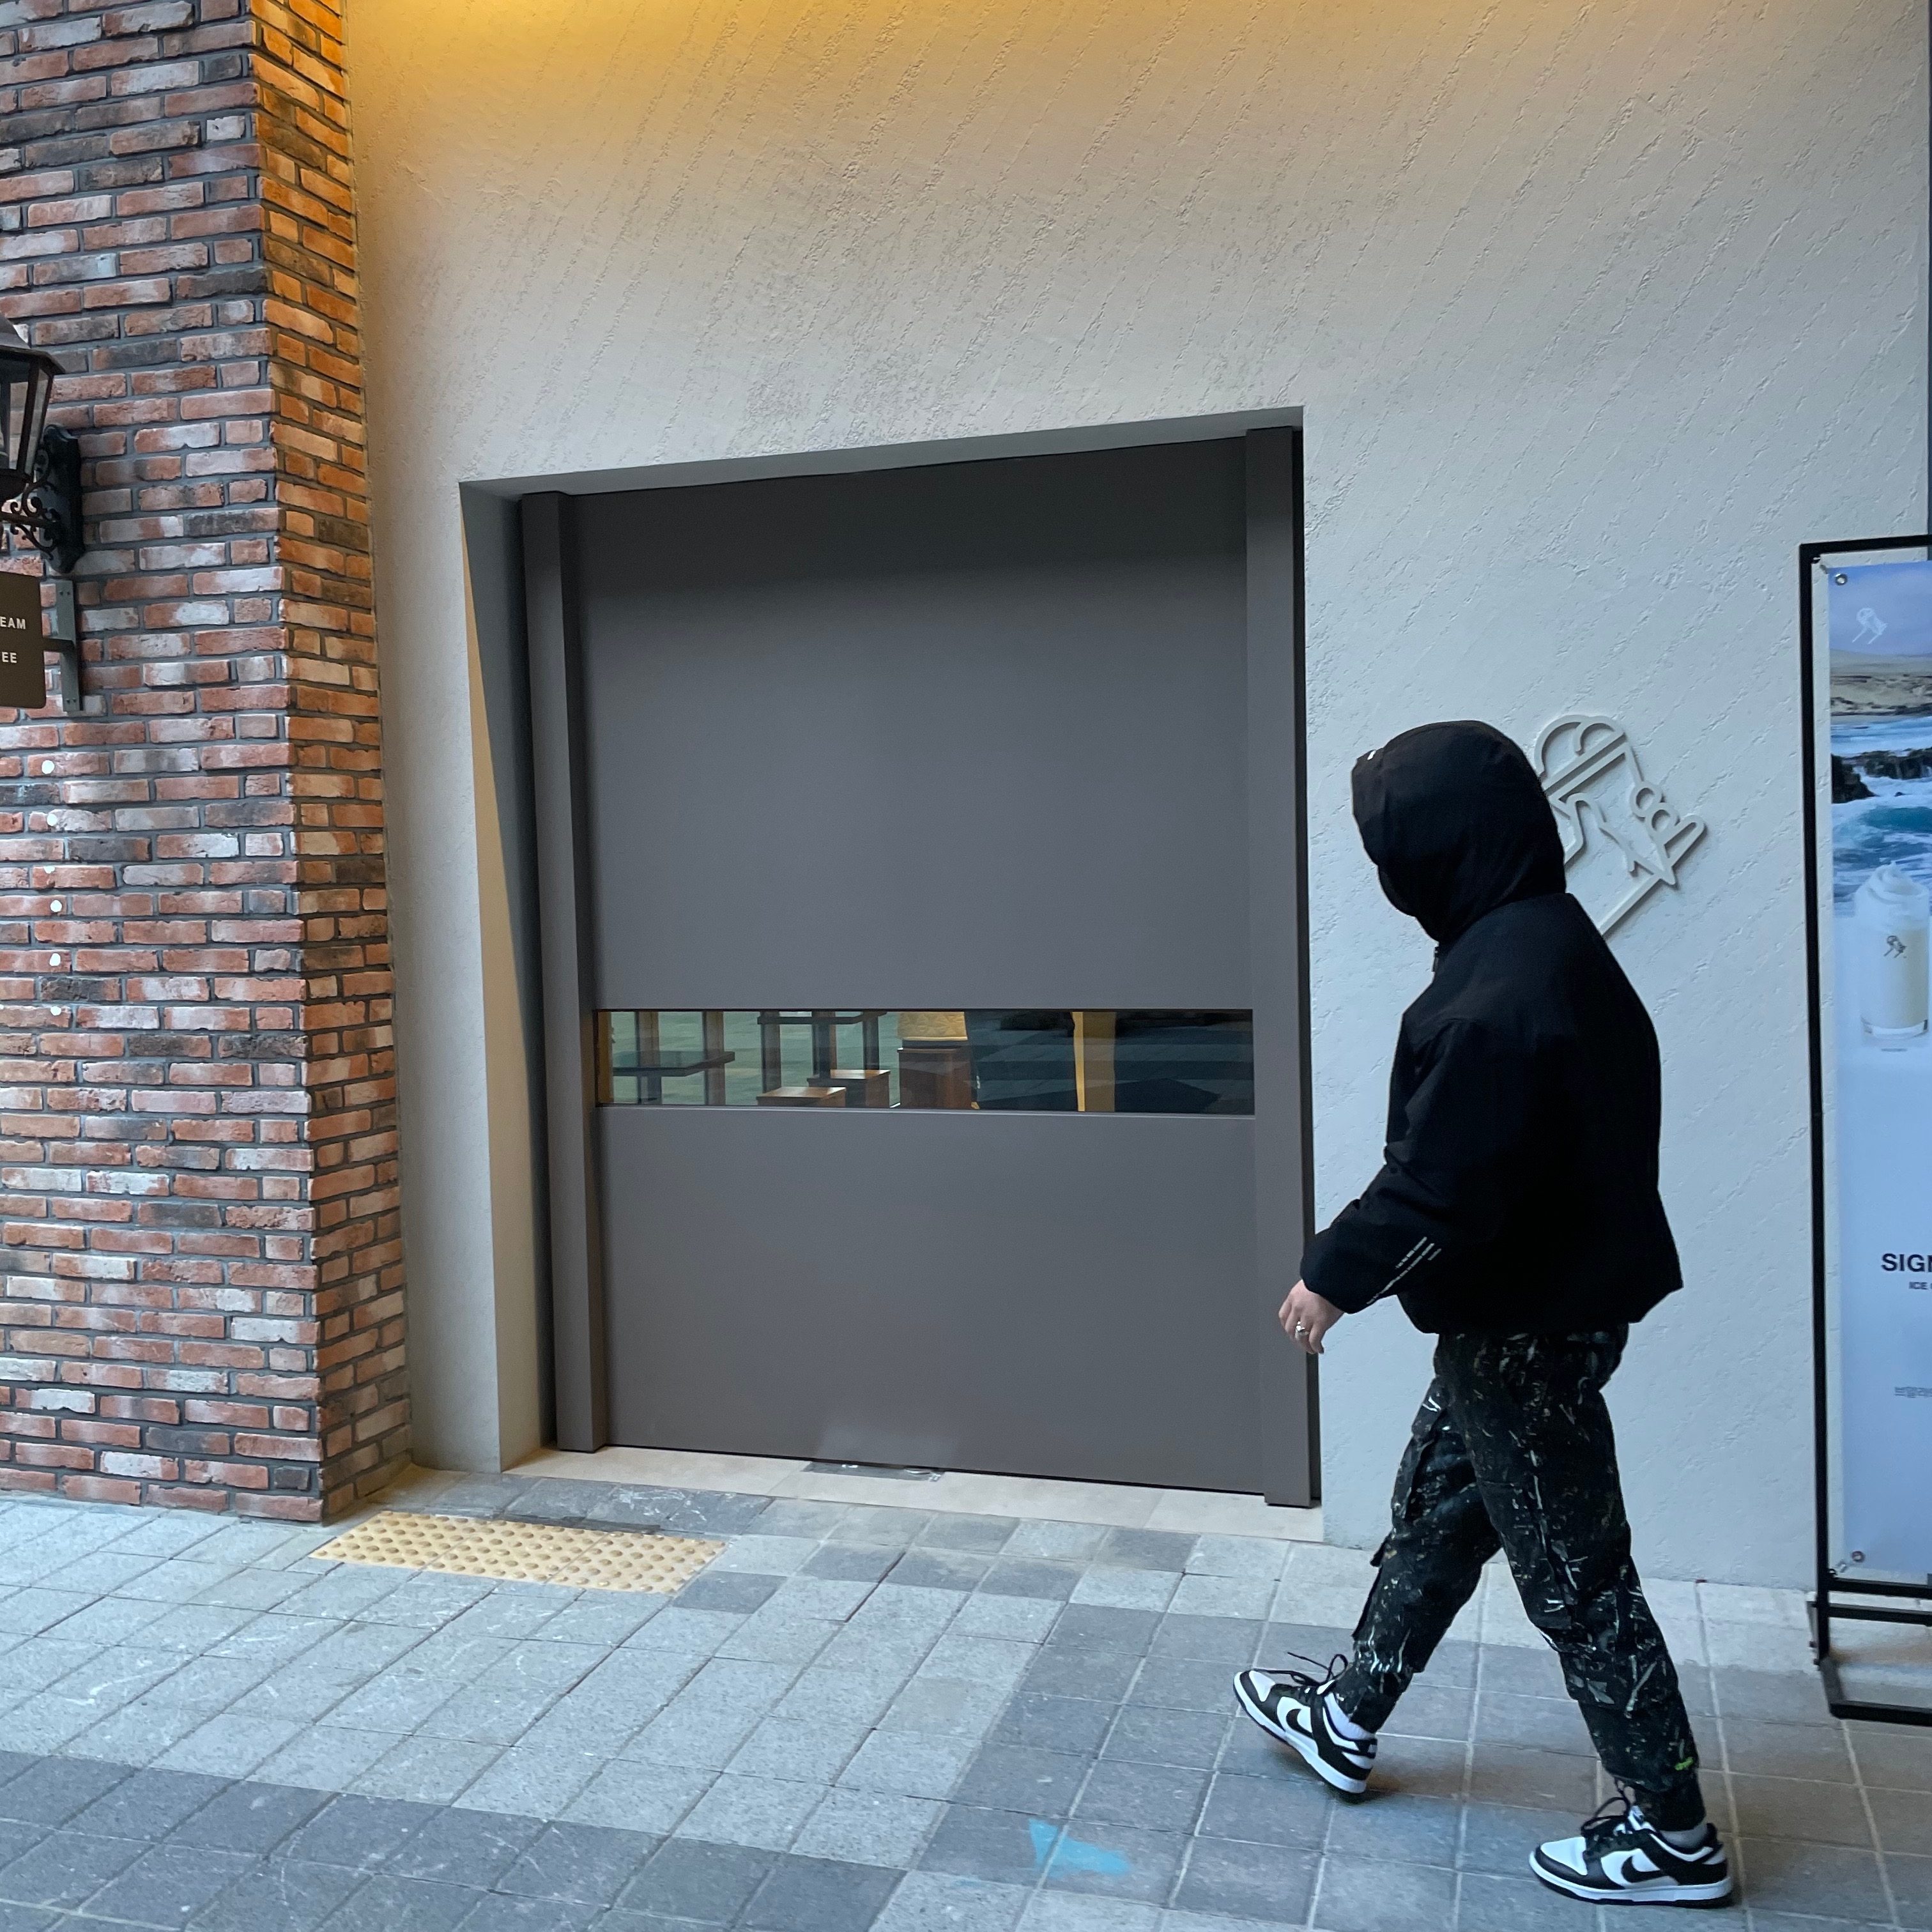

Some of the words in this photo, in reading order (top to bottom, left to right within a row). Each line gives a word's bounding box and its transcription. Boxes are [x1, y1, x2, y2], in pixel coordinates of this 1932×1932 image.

[0, 616, 26, 629] EAM
[2, 652, 17, 663] EE
[1882, 1253, 1932, 1272] SIG
